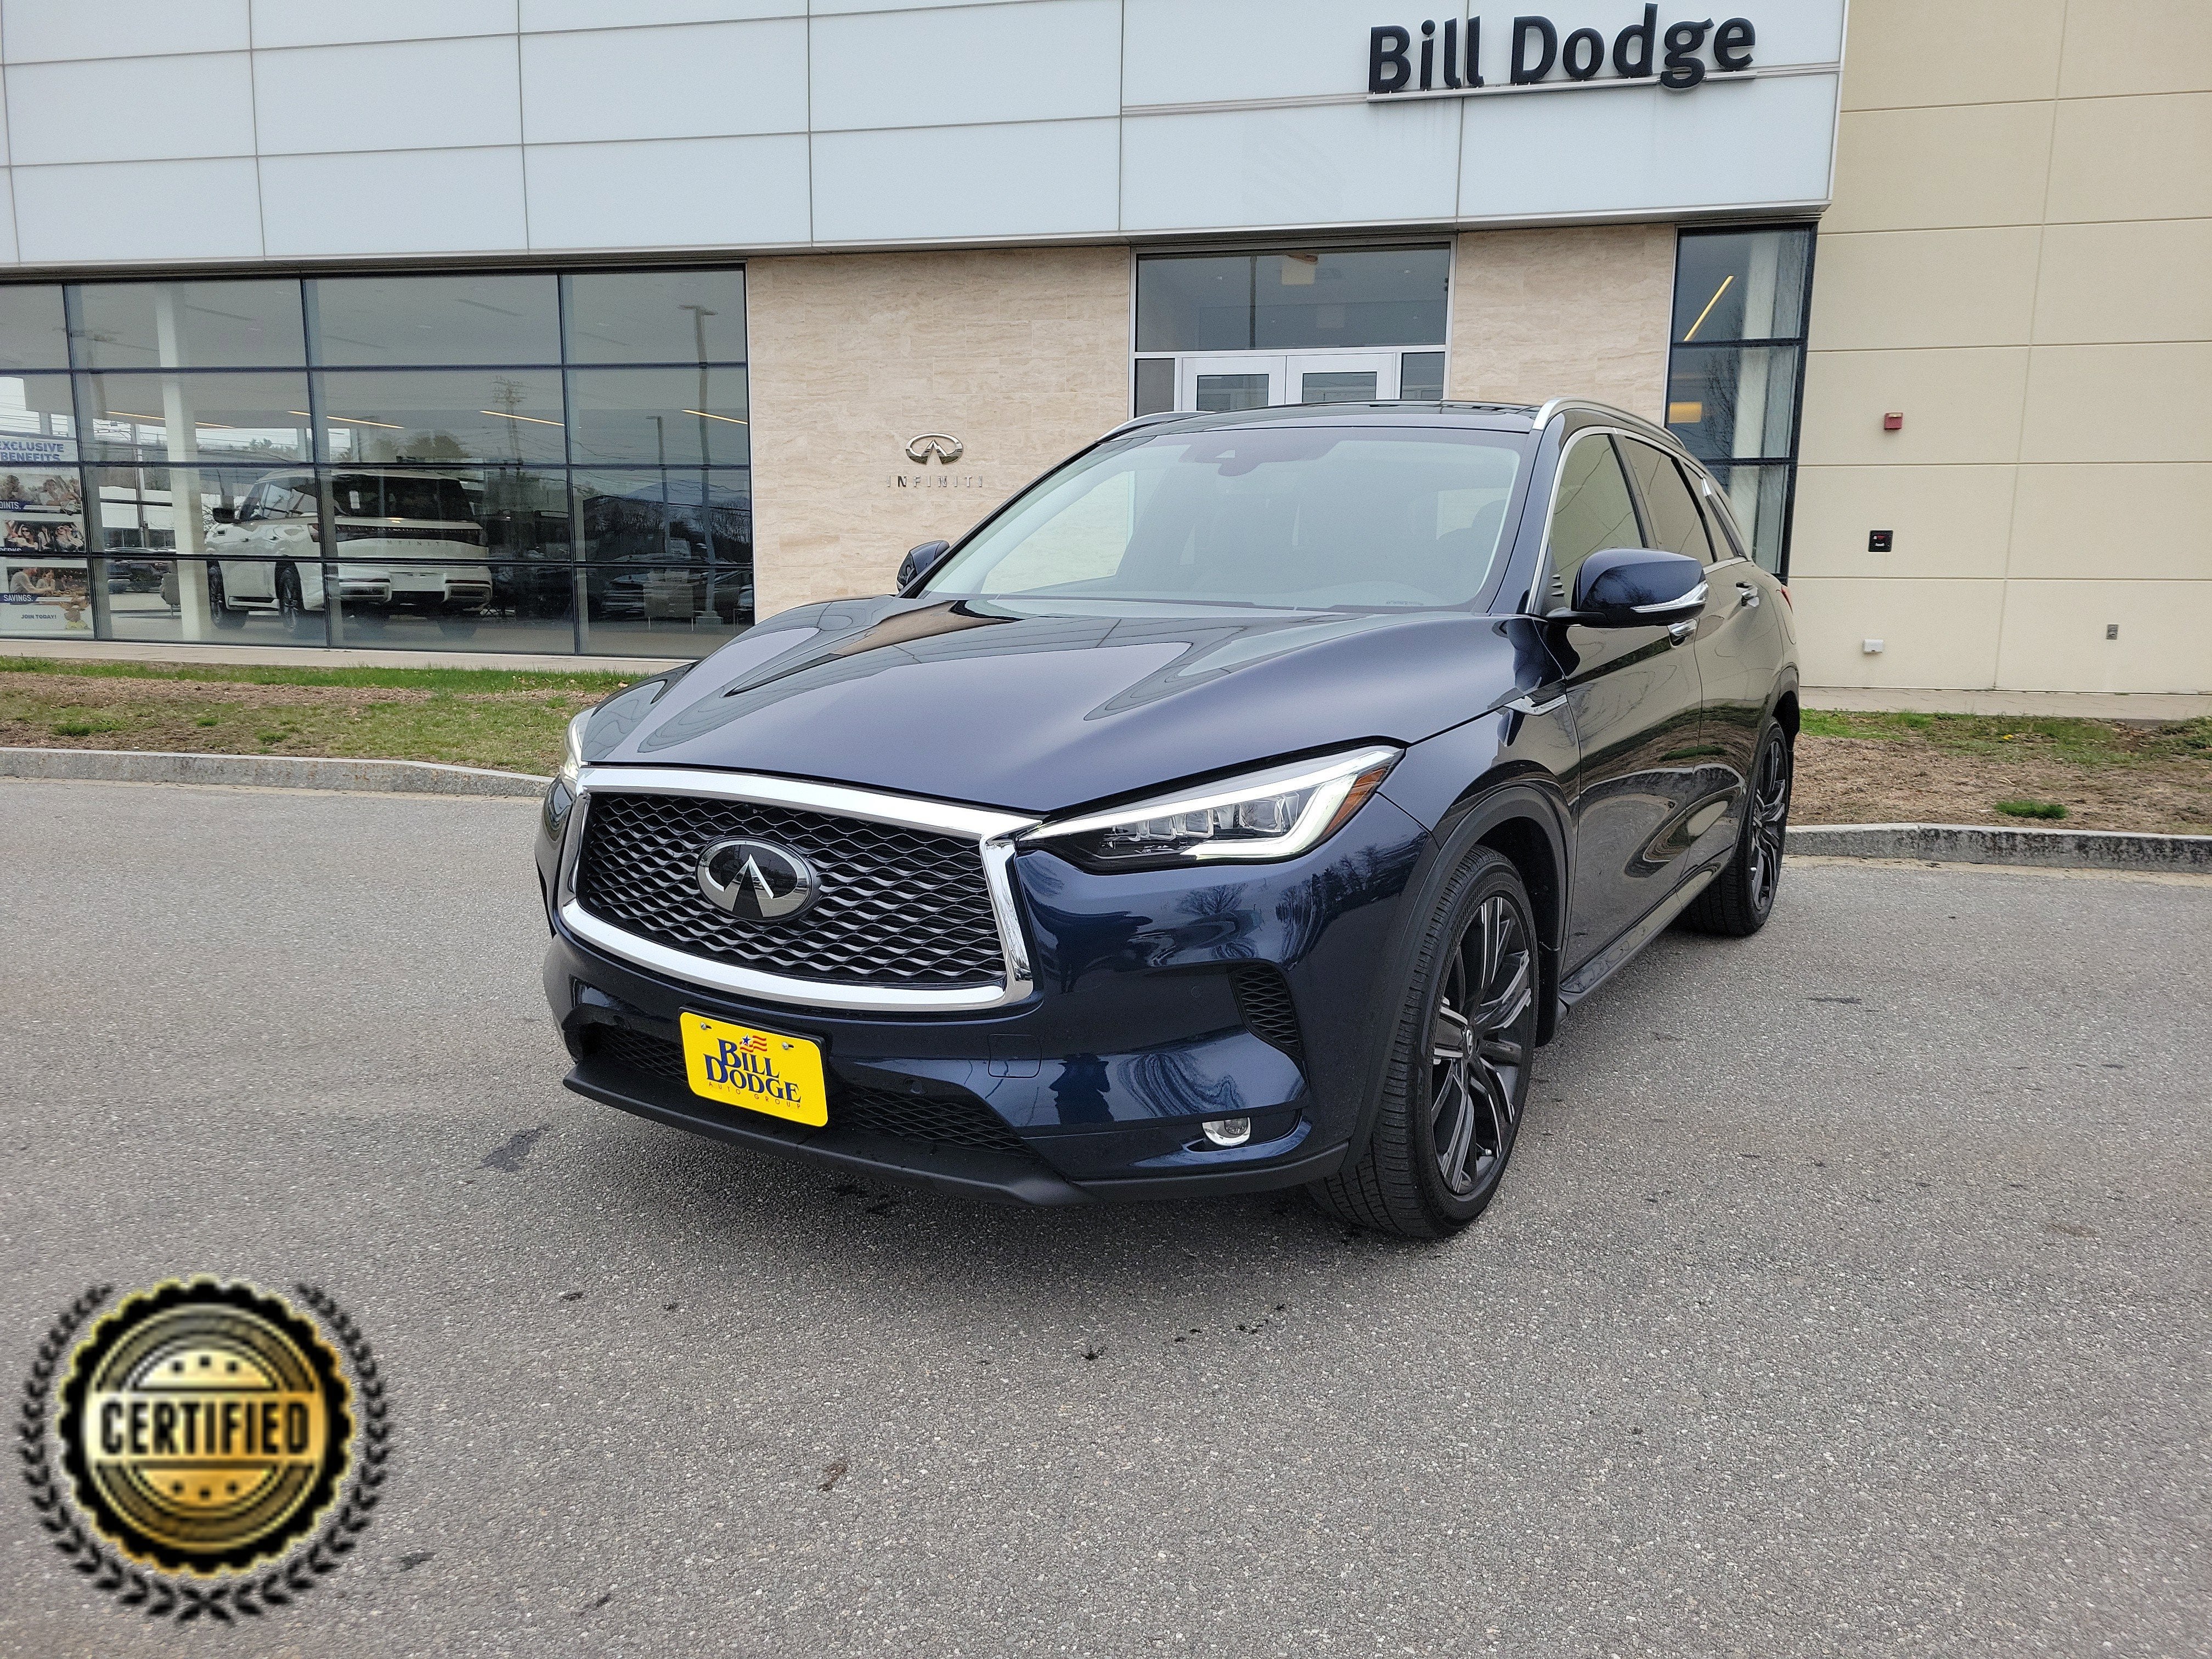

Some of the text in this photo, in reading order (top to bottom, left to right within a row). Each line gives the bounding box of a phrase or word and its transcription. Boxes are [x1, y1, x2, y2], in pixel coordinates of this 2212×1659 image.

[1368, 3, 1756, 92] Bill Dodge
[0, 441, 64, 453] XCLUSIVE
[1, 452, 60, 461] BENEFITS
[885, 475, 983, 488] INFINITI
[717, 1038, 780, 1079] BILL
[703, 1053, 802, 1103] DODGE
[708, 1081, 801, 1109] AUTO GROUP
